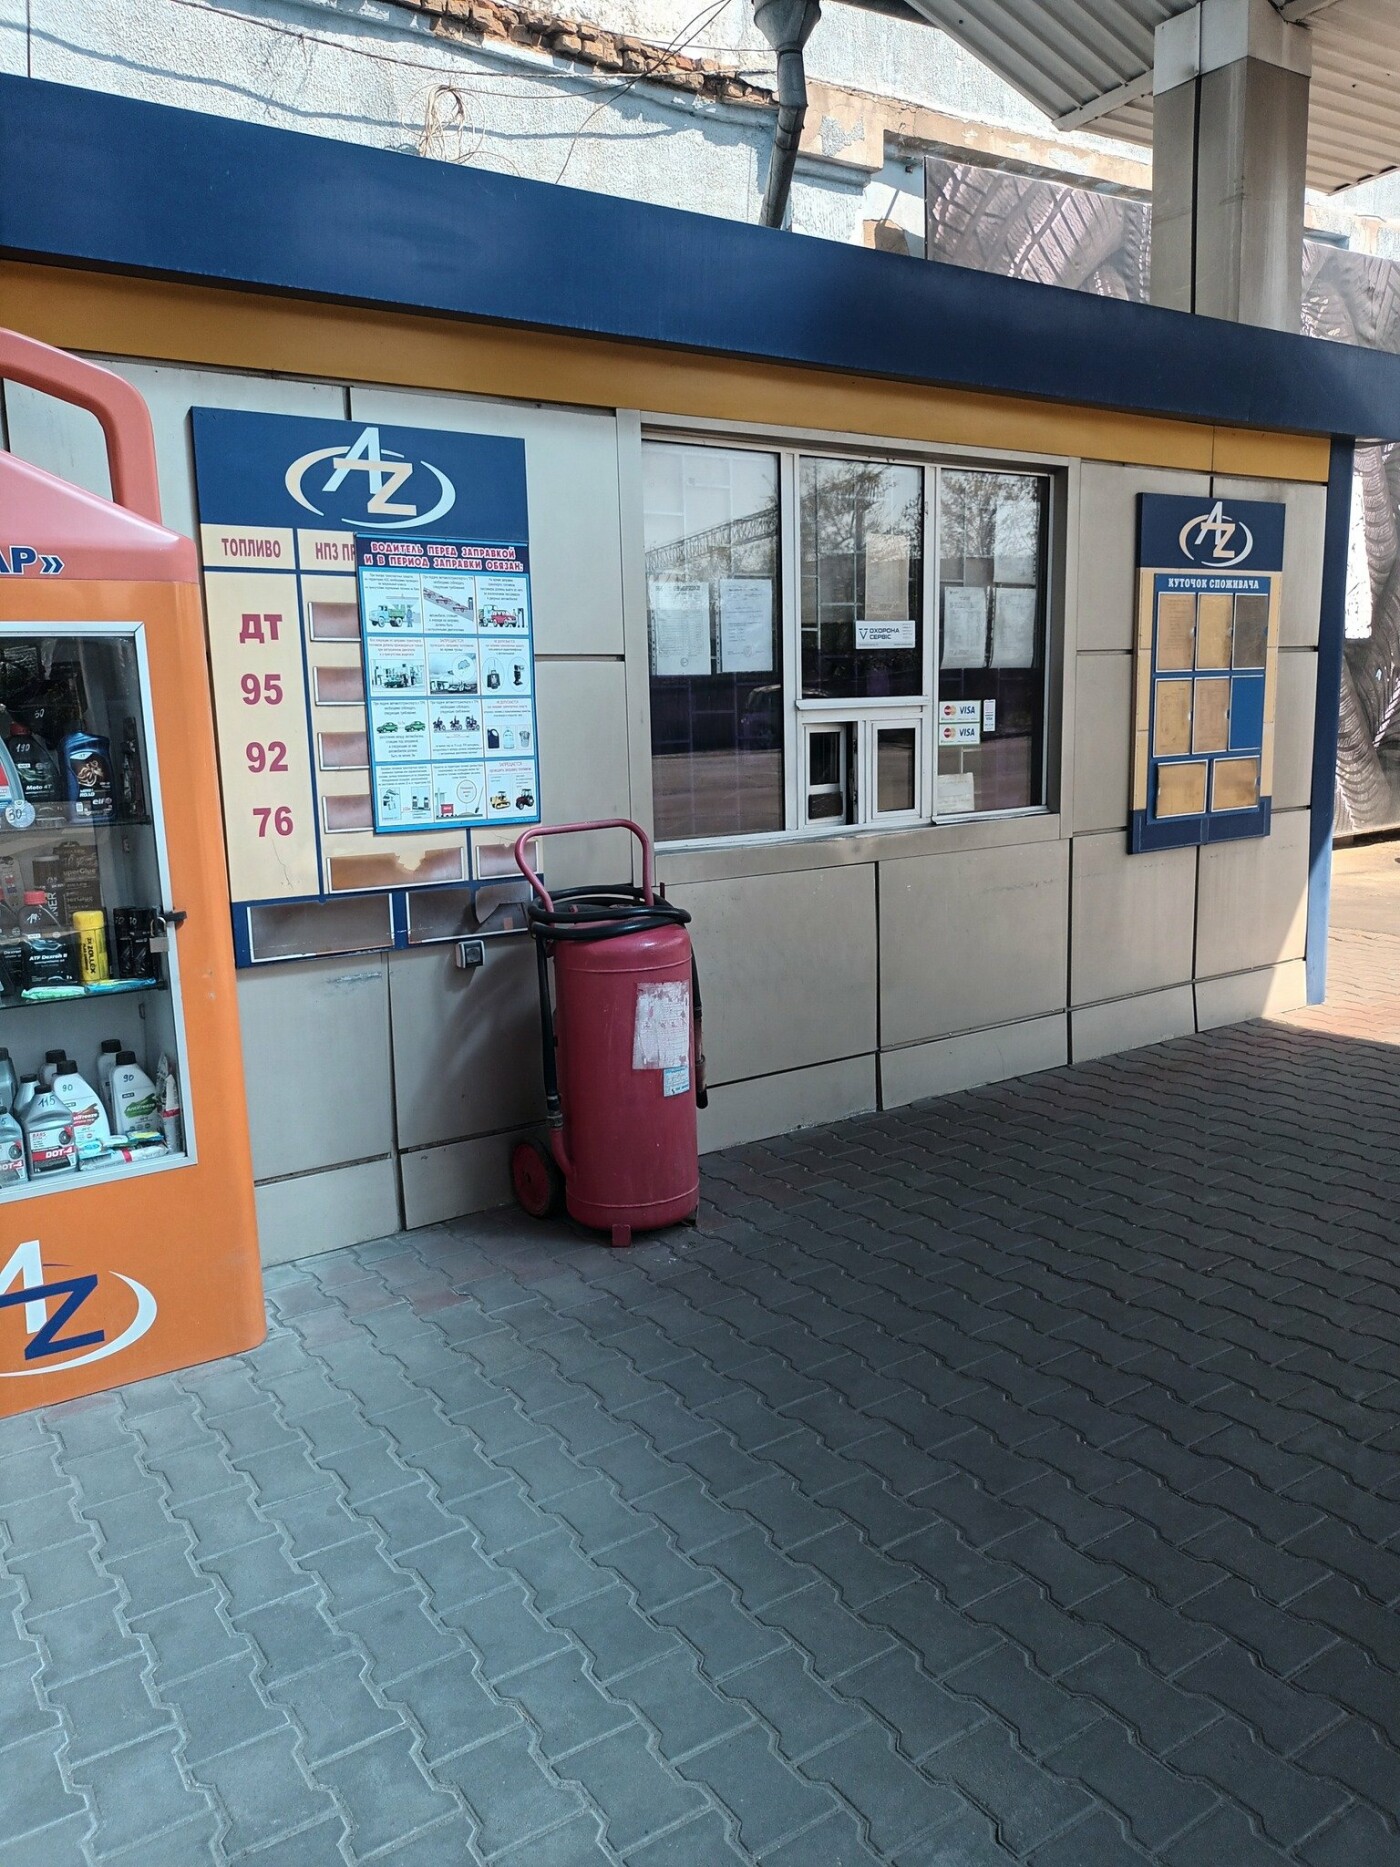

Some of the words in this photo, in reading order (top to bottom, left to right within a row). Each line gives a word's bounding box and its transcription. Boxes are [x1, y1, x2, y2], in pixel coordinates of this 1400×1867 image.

[221, 538, 281, 558] ТОПЛИВО
[315, 542, 339, 561] НПЗ
[371, 542, 423, 555] ВОДИТЕЛЬ
[428, 545, 457, 557] ПЕРЕД
[462, 547, 516, 559] ЗАПРАВКОЙ
[364, 554, 373, 565] И
[378, 555, 385, 566] В
[390, 556, 429, 567] ПЕРИОД
[433, 559, 482, 570] ЗАПРАВКИ
[486, 562, 524, 571] ОБЯЗАН:
[1168, 578, 1208, 588] КУТОЧОК
[1209, 579, 1260, 589] СПОЖИВАЧА
[239, 614, 283, 643] ДТ
[240, 673, 284, 706] 95
[959, 705, 976, 715] VISA
[959, 727, 975, 737] VISA
[245, 741, 289, 774] 92
[252, 806, 295, 839] 76
[123, 1074, 135, 1082] 90
[62, 1084, 74, 1092] 90
[38, 1094, 56, 1107] 115
[46, 1146, 73, 1158] DOT-4
[0, 1160, 23, 1170] OT-4
